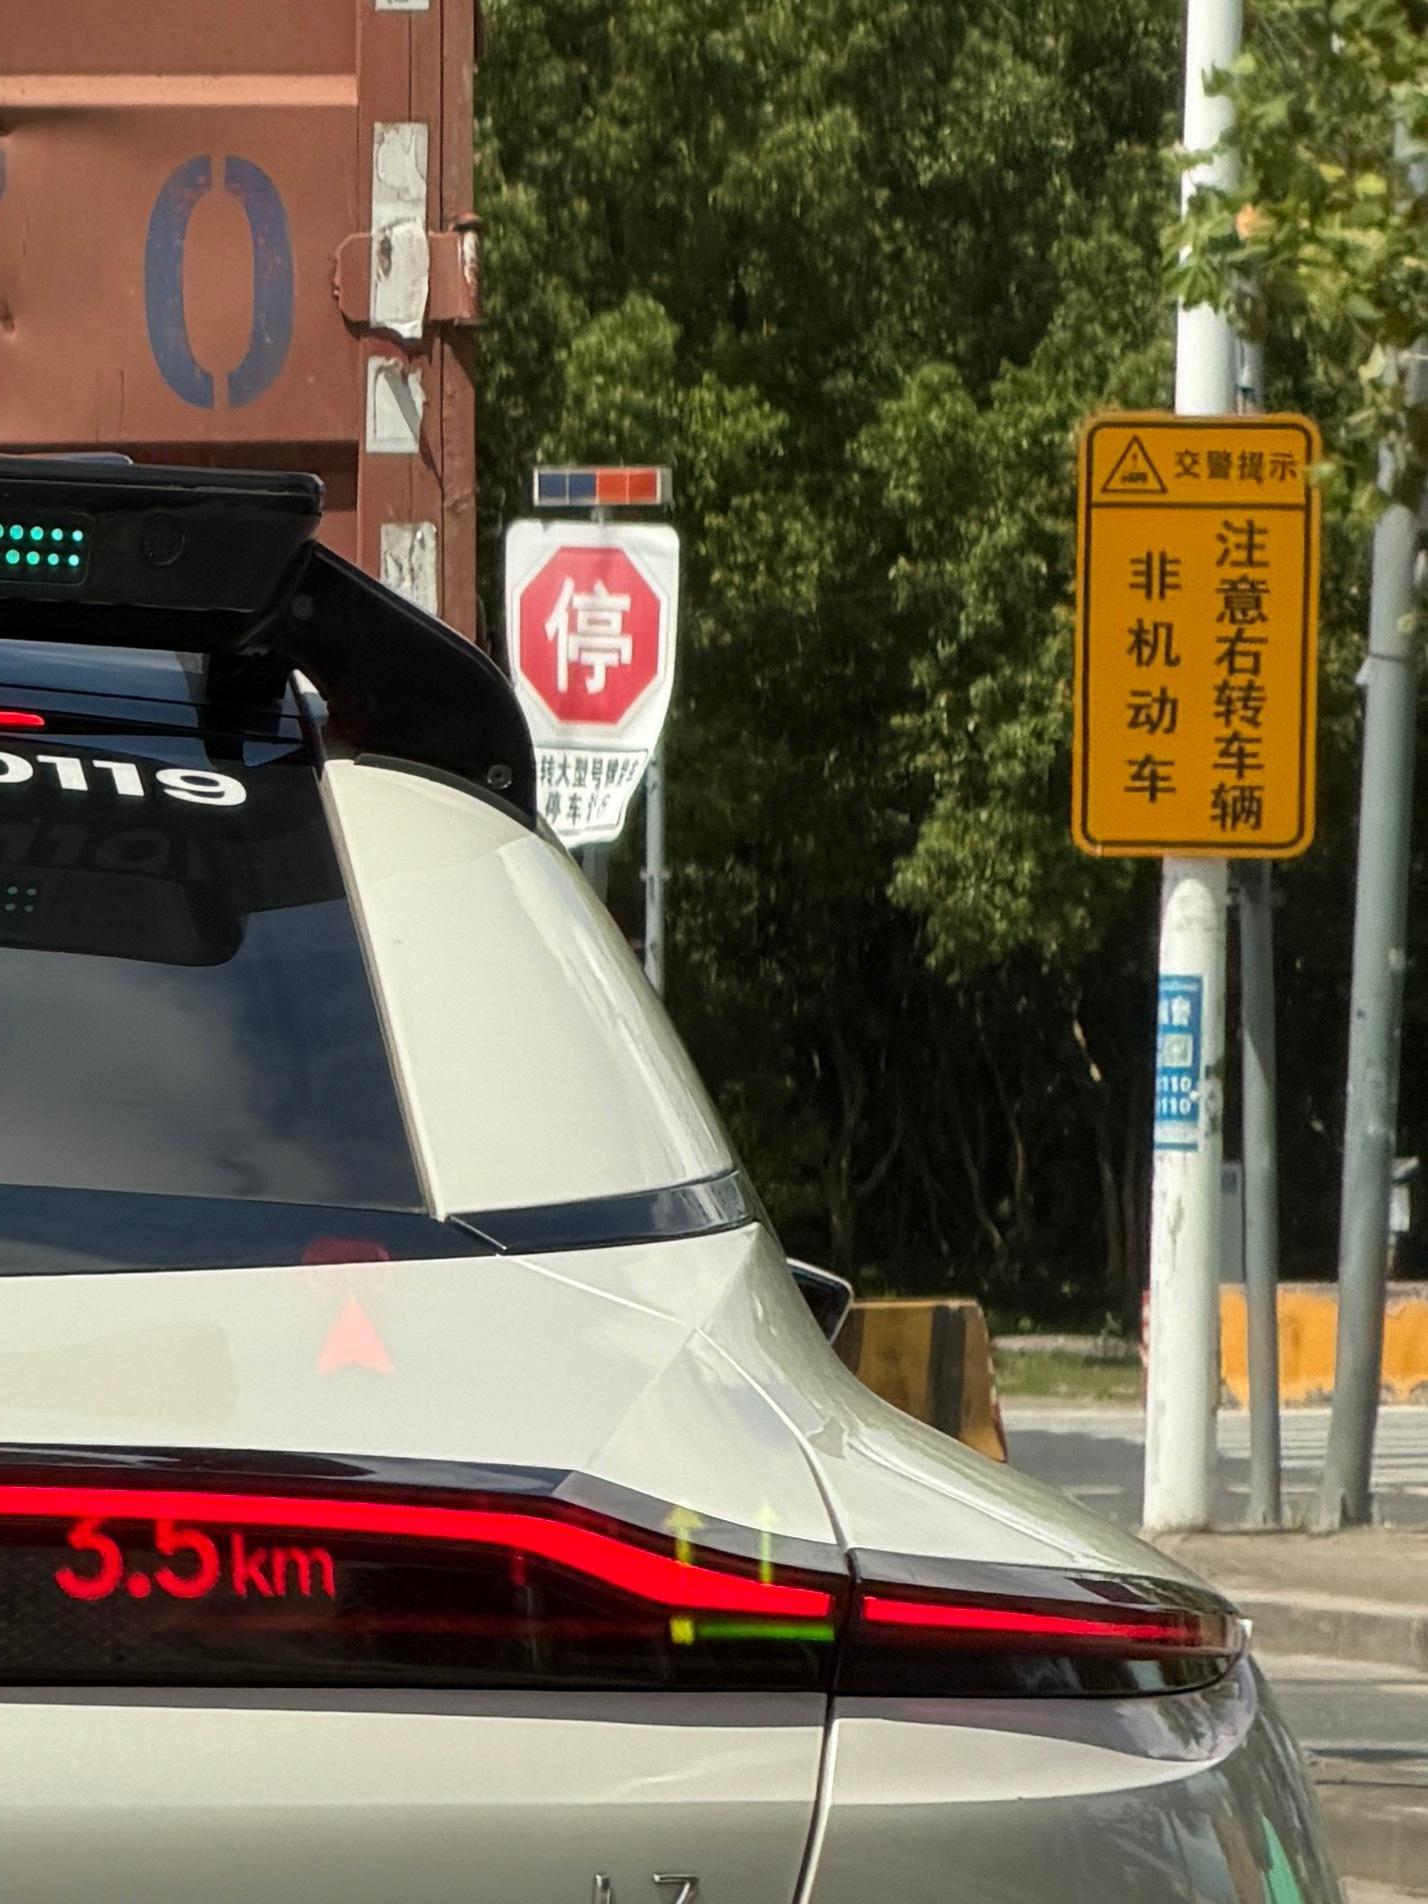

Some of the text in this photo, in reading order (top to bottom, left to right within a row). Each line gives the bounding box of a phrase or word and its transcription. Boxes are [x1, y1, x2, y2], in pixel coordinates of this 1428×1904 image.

[1174, 449, 1298, 484] 交警提示
[545, 576, 634, 695] 停
[1123, 550, 1183, 804] 非机动车
[1210, 518, 1270, 833] 注意右转车辆
